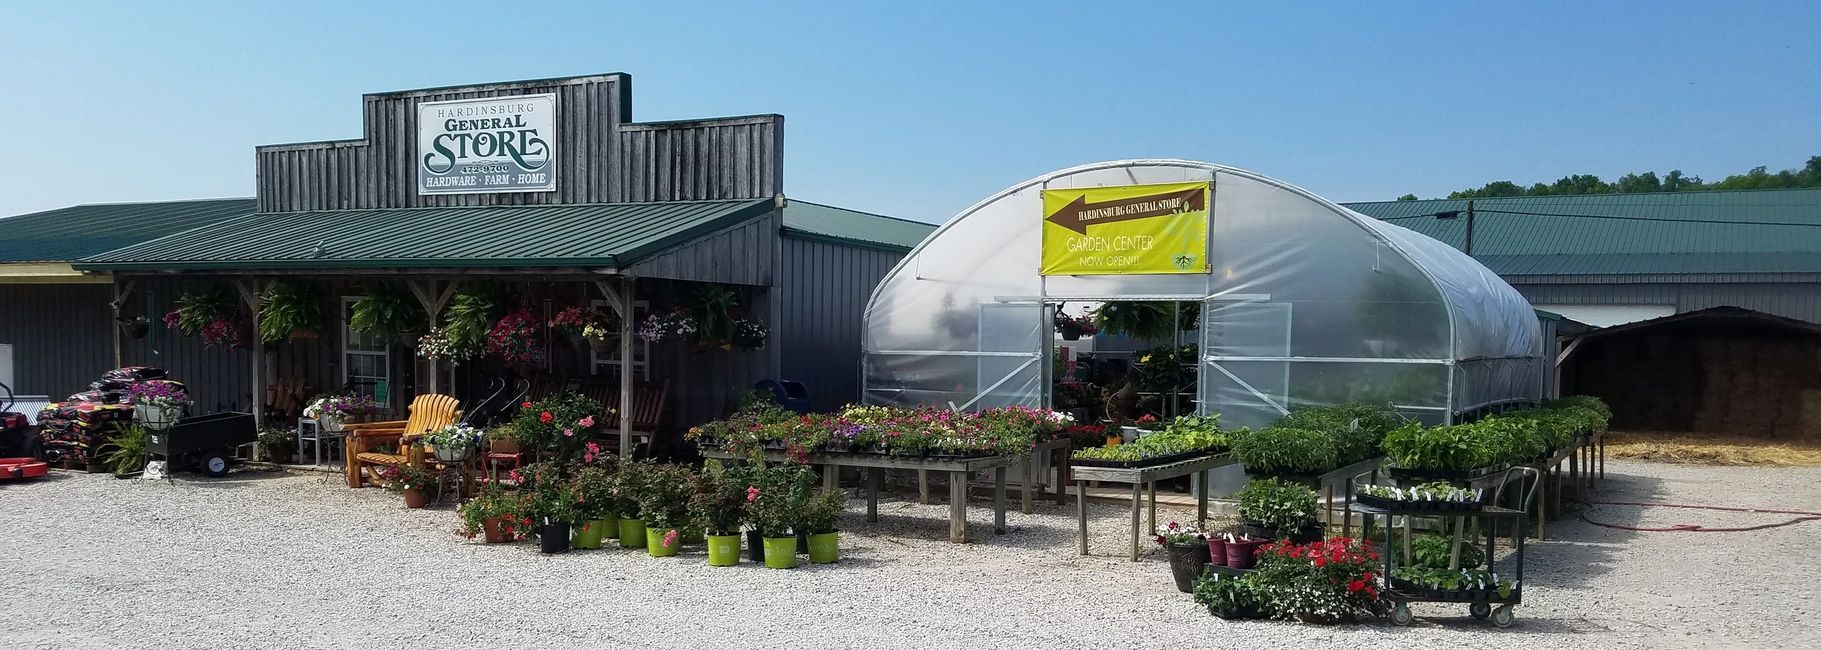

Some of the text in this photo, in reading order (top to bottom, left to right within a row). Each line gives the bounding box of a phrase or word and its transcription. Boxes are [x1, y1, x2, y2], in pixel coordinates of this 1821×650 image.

[437, 103, 535, 118] HARDINSBURG
[444, 114, 527, 132] GENERAL
[423, 129, 550, 174] STORE
[460, 165, 510, 174] 472-9700
[426, 173, 546, 187] HARDWARE FARM HOME
[1078, 197, 1182, 220] HARDINSBURG GENERAL STORE
[1066, 235, 1153, 252] GARDEN CENTER
[1079, 255, 1140, 266] NOW OPEN!!!
